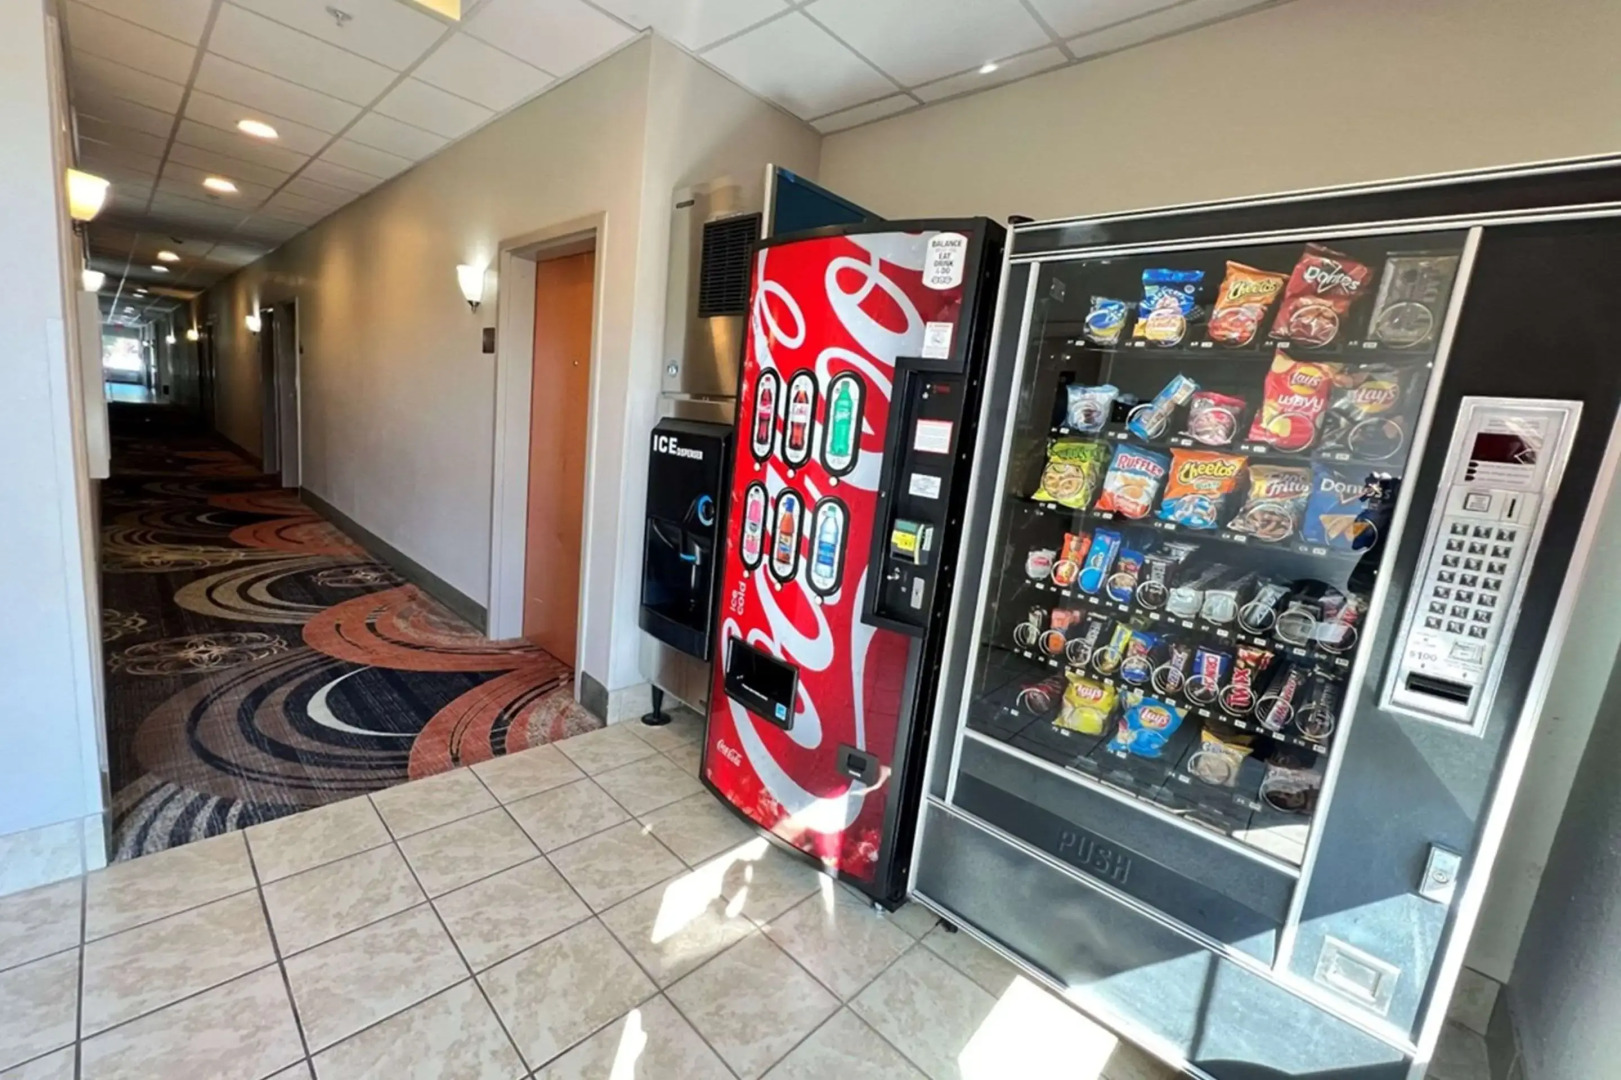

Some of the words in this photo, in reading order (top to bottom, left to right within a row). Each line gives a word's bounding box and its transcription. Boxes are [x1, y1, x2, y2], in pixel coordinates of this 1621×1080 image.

[1227, 279, 1280, 301] Cheetos
[653, 434, 678, 455] ICE
[1118, 454, 1164, 478] RUFFLES
[1179, 460, 1236, 483] Cheetos
[729, 590, 738, 612] ice
[737, 580, 747, 616] cold
[1227, 667, 1251, 708] TWIX
[1059, 831, 1131, 884] PUSH
